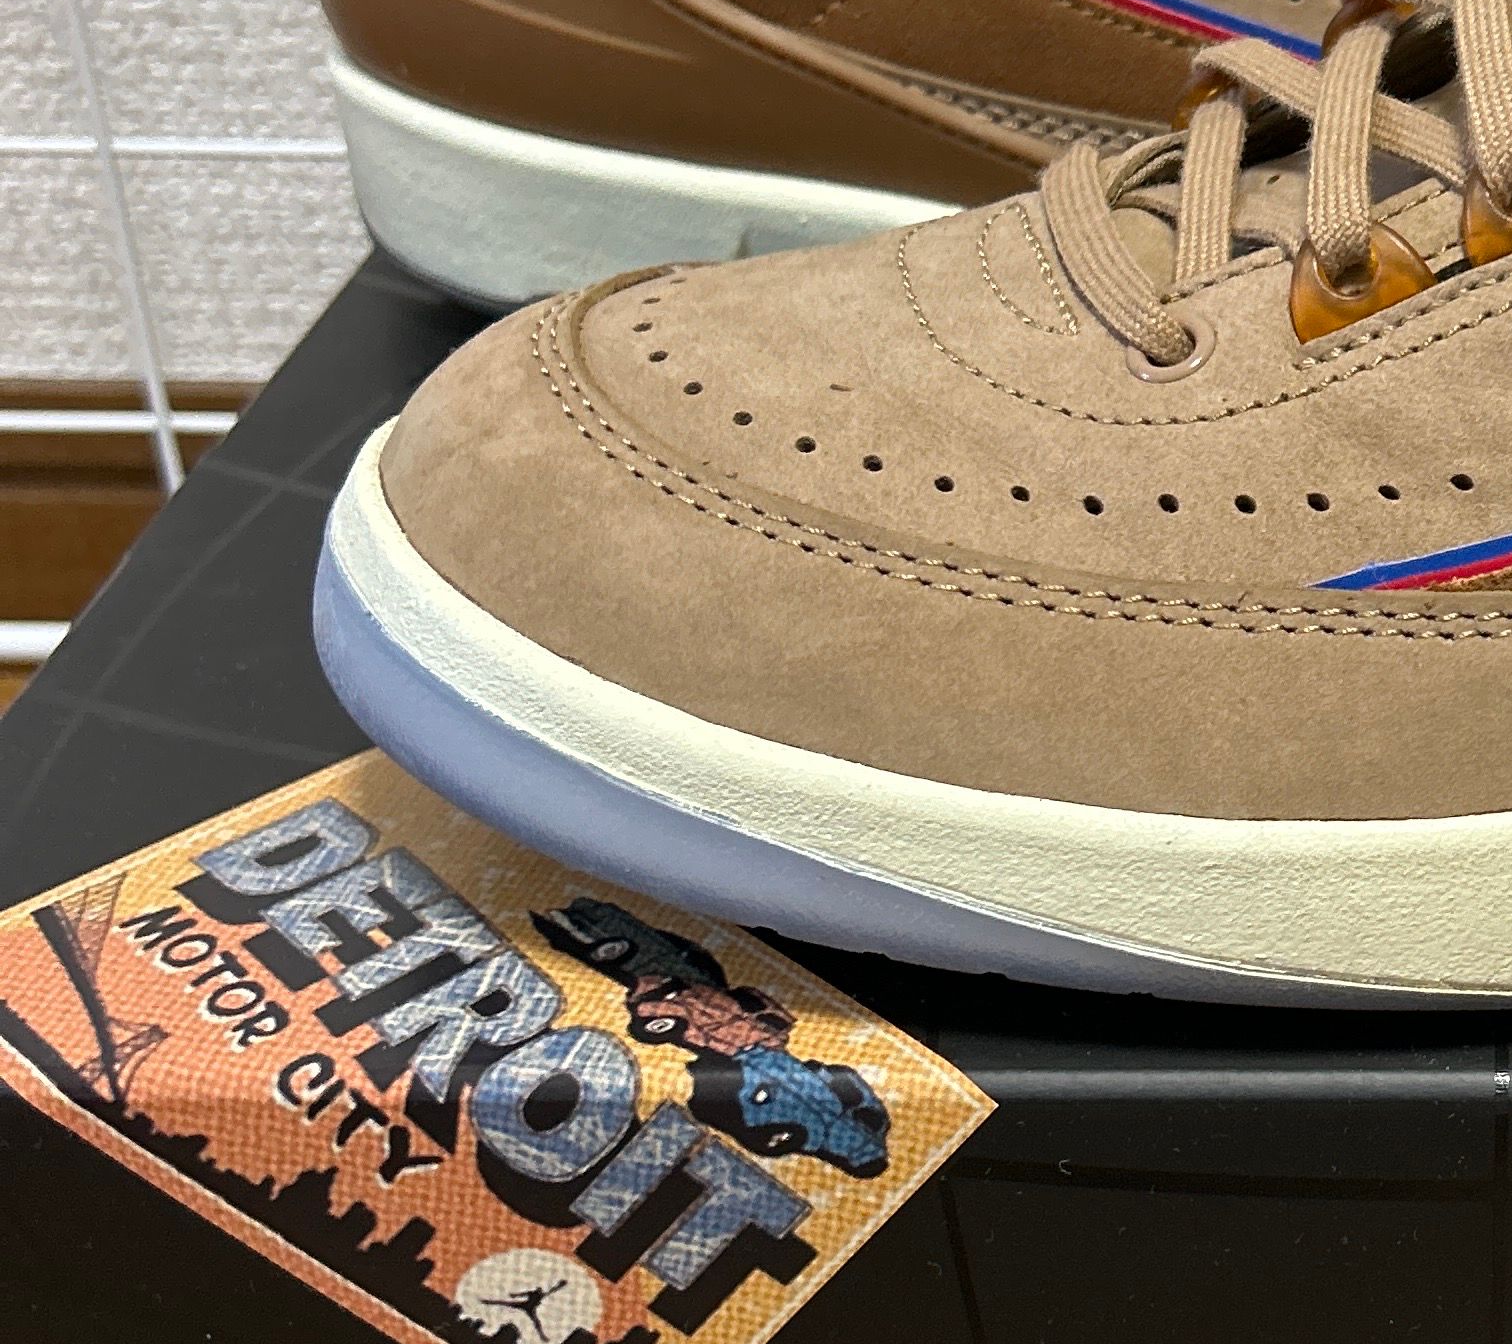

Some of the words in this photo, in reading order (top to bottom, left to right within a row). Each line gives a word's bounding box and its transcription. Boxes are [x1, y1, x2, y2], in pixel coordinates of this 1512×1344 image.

[118, 905, 292, 1049] MOTOR
[279, 1053, 444, 1183] CITY
[194, 796, 813, 1292] DETROIT
